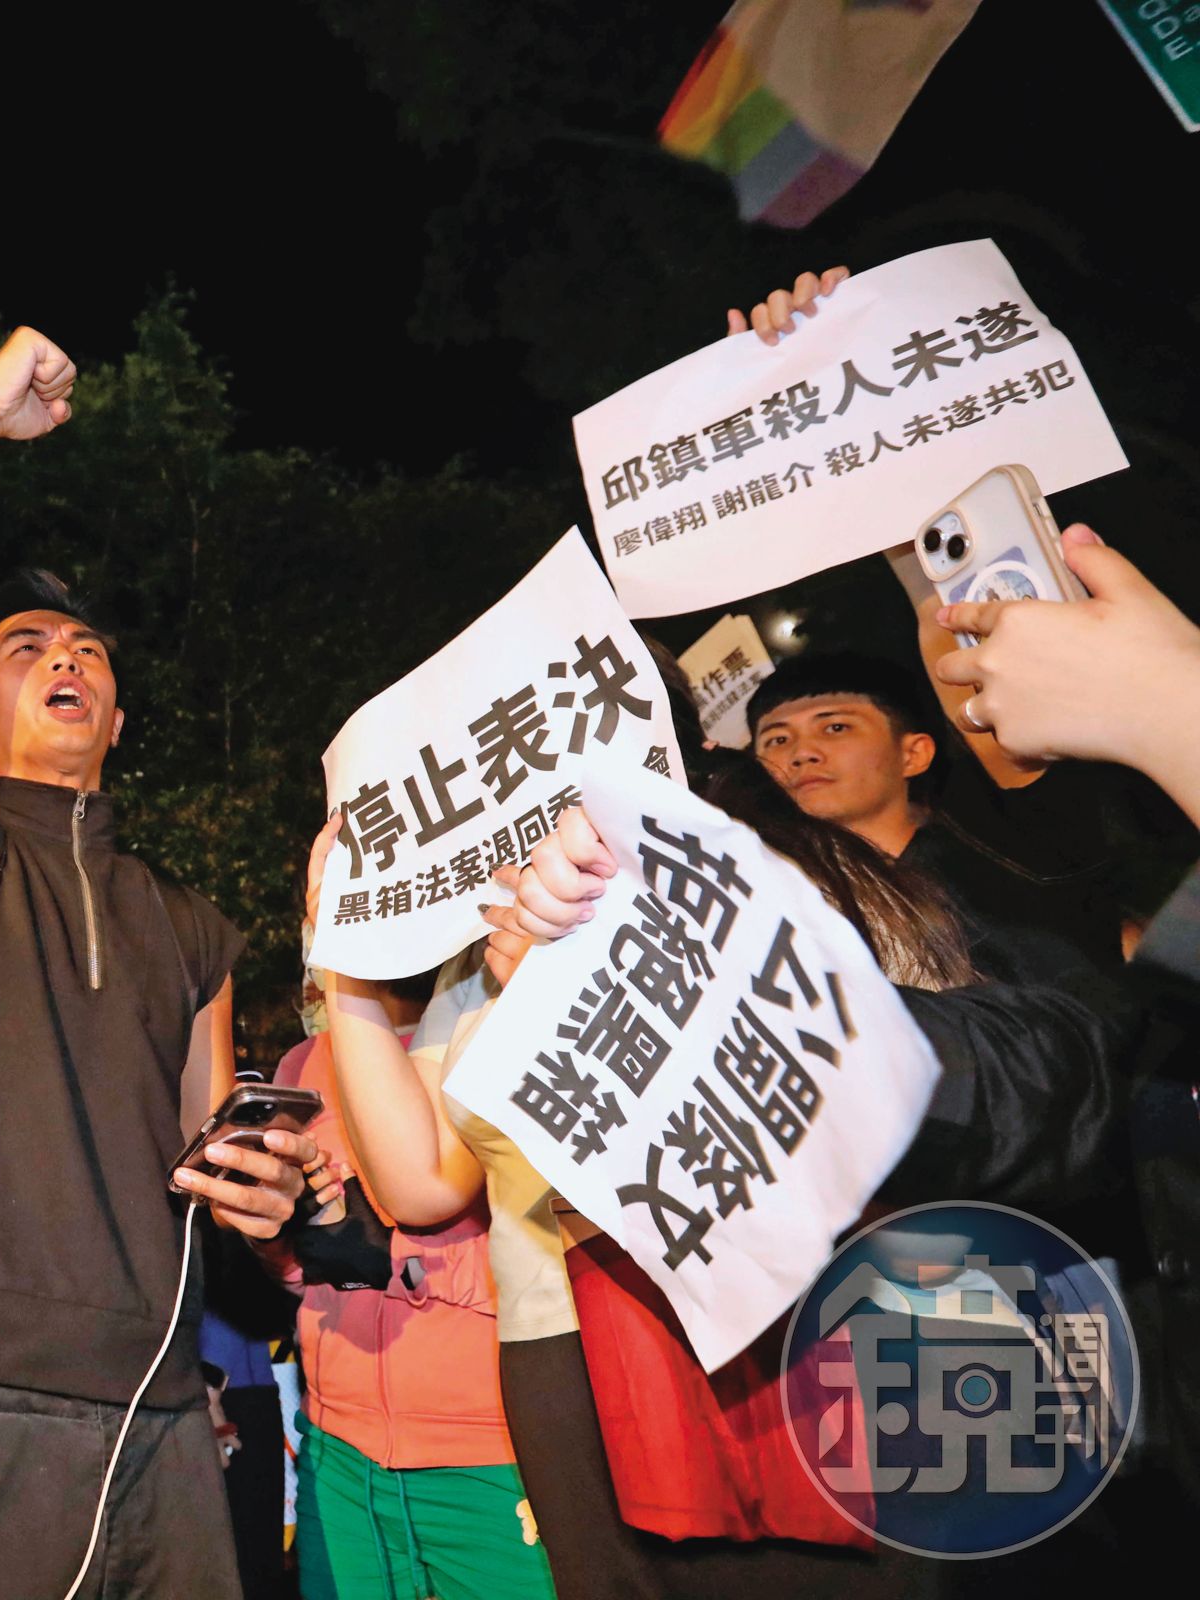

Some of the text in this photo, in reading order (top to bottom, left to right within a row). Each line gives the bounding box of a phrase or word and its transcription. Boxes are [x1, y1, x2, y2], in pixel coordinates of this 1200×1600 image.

[601, 300, 1041, 511] 邱鎮軍殺人未遂
[613, 359, 1076, 558] 廖偉翔 謝龍介 殺人未遂共犯
[336, 634, 653, 880] 停止表決
[508, 813, 755, 1166] 拒絕黑箱
[616, 916, 860, 1272] 公開條文
